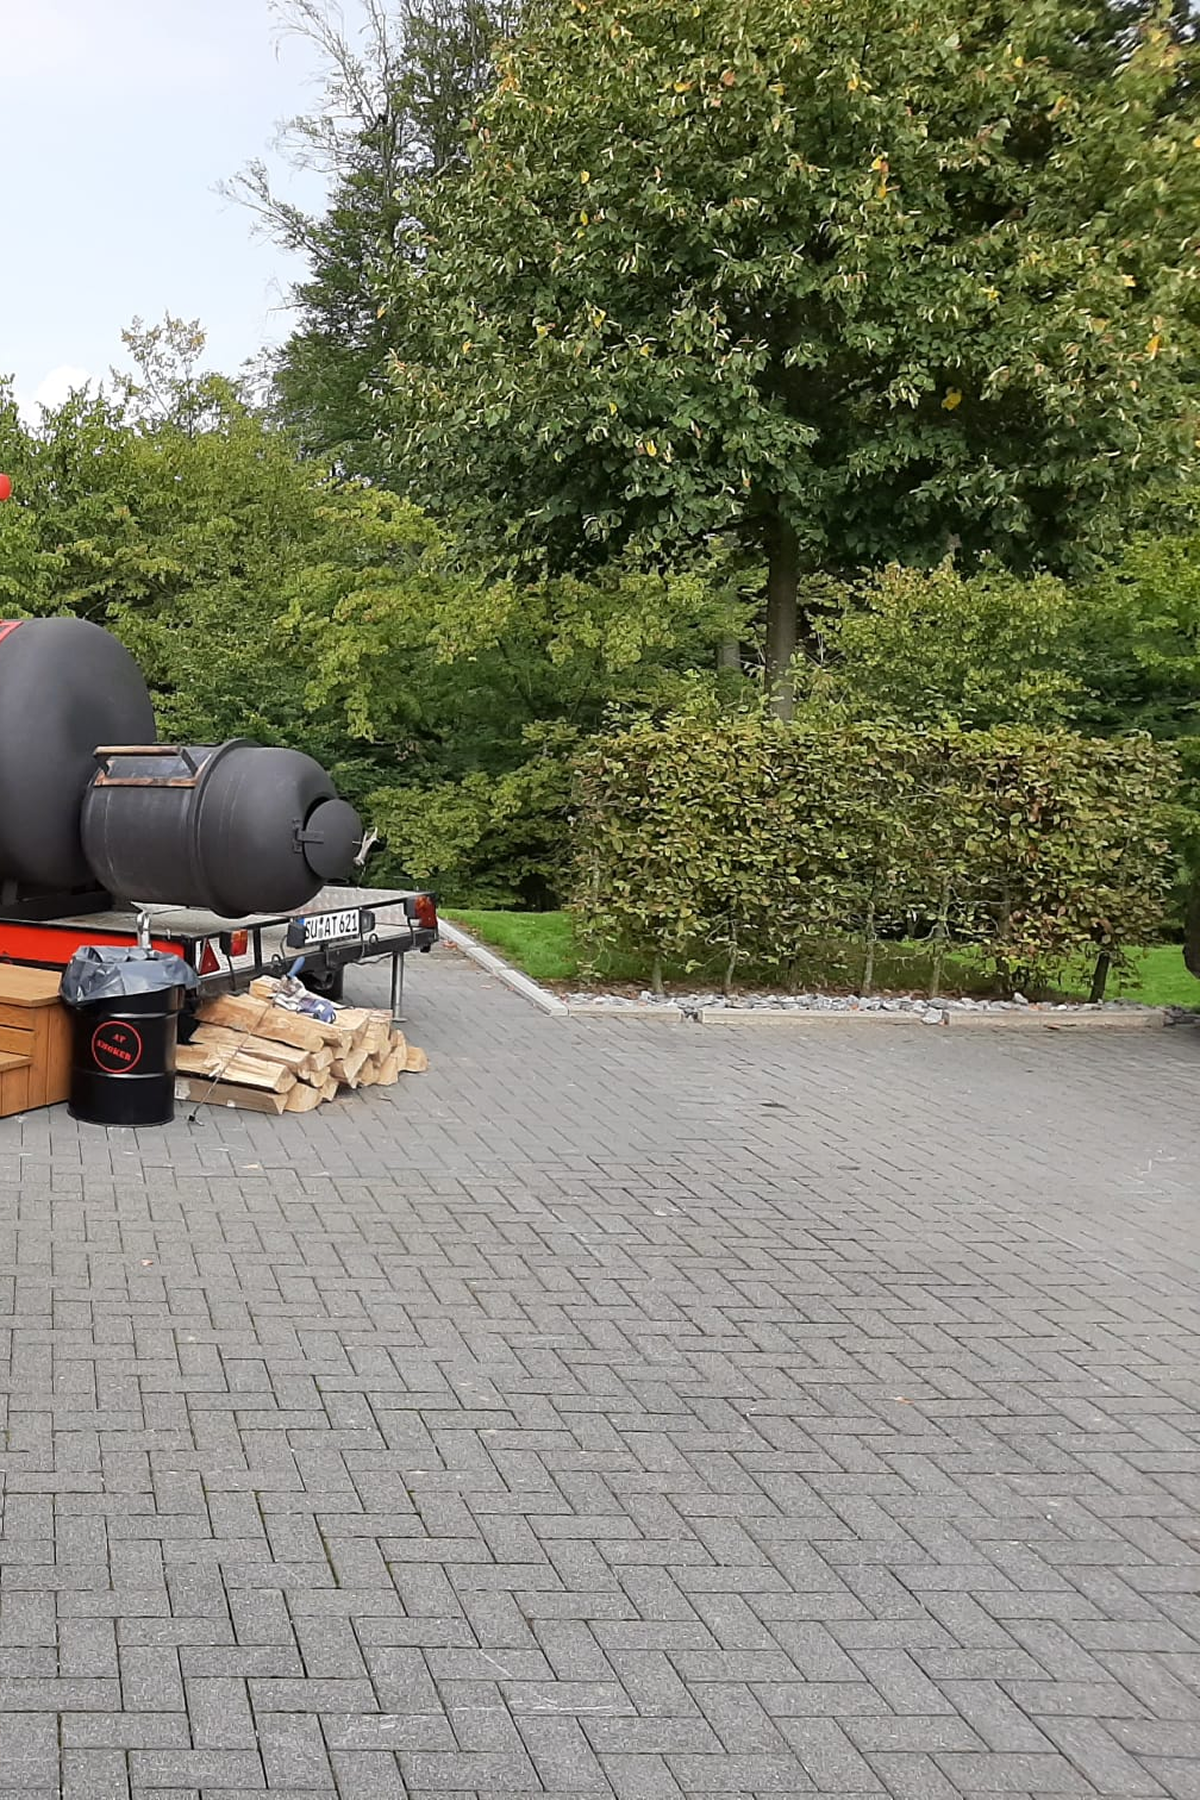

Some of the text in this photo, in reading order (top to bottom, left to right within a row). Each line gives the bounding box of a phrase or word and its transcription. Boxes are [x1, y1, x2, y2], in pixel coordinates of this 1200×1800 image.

[305, 912, 358, 940] SU AT 621
